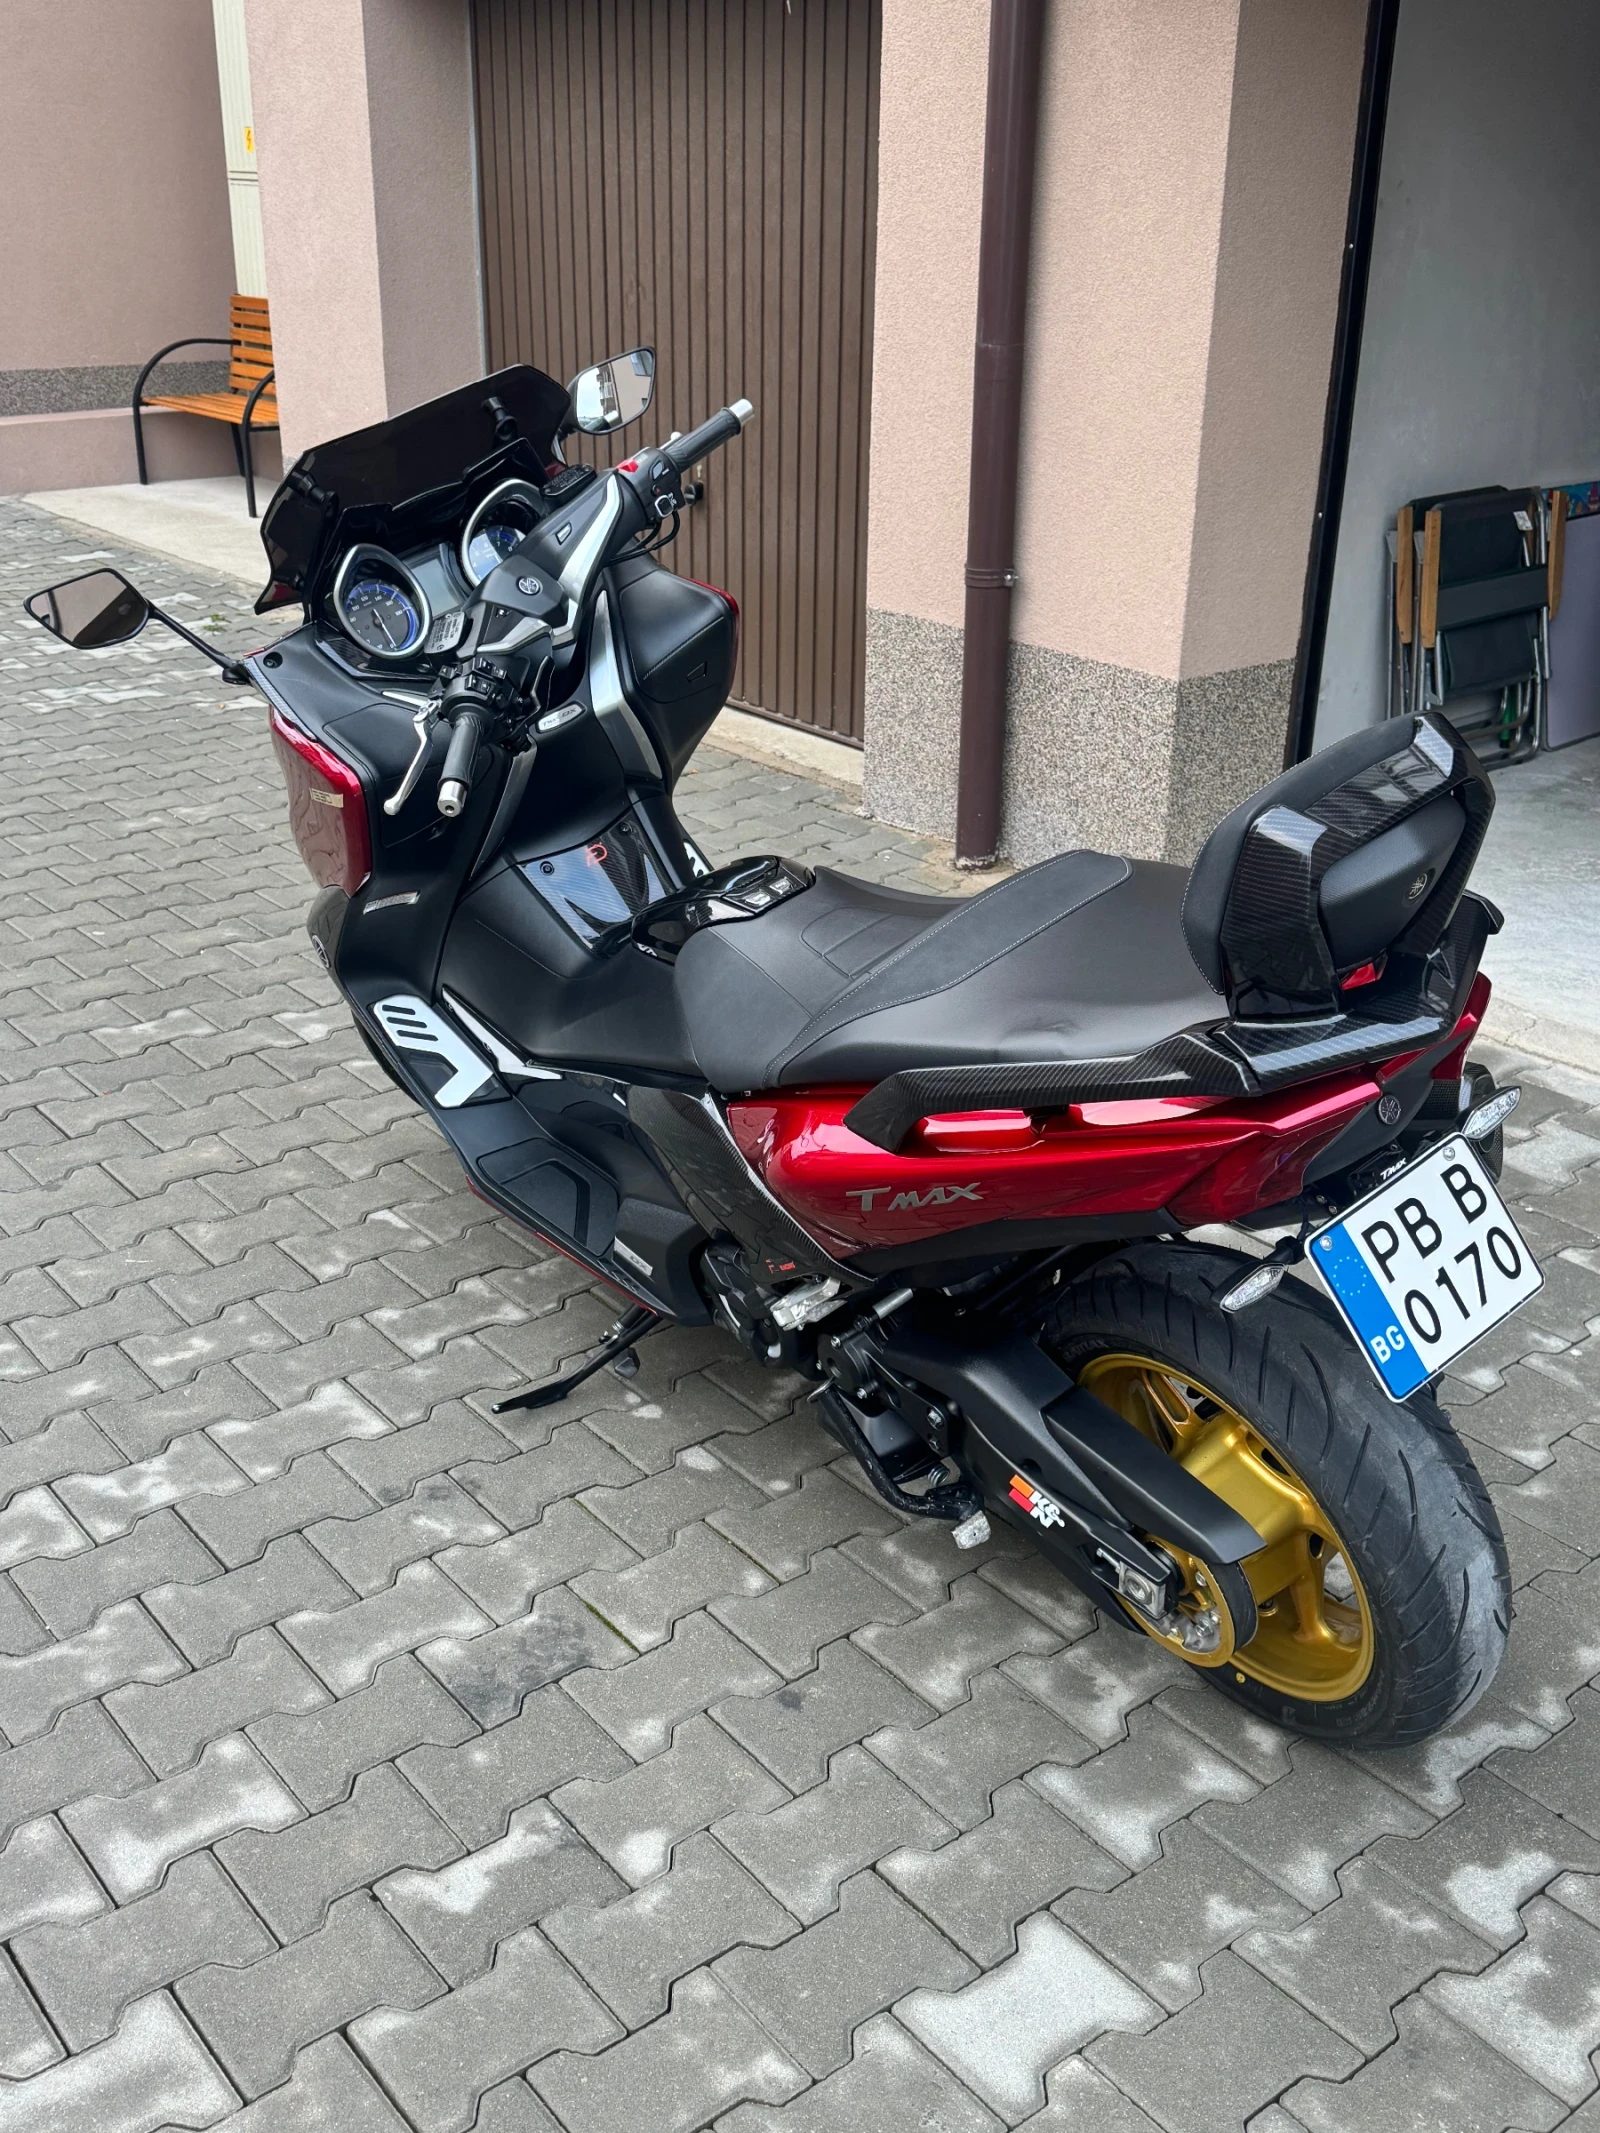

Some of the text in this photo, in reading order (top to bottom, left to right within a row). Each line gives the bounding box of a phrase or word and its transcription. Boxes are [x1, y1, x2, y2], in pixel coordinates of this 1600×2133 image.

[561, 707, 577, 718] DX
[1380, 1157, 1408, 1181] TMAX
[1360, 1163, 1488, 1284] PB B
[1404, 1226, 1522, 1345] 0170
[1370, 1325, 1406, 1364] BG
